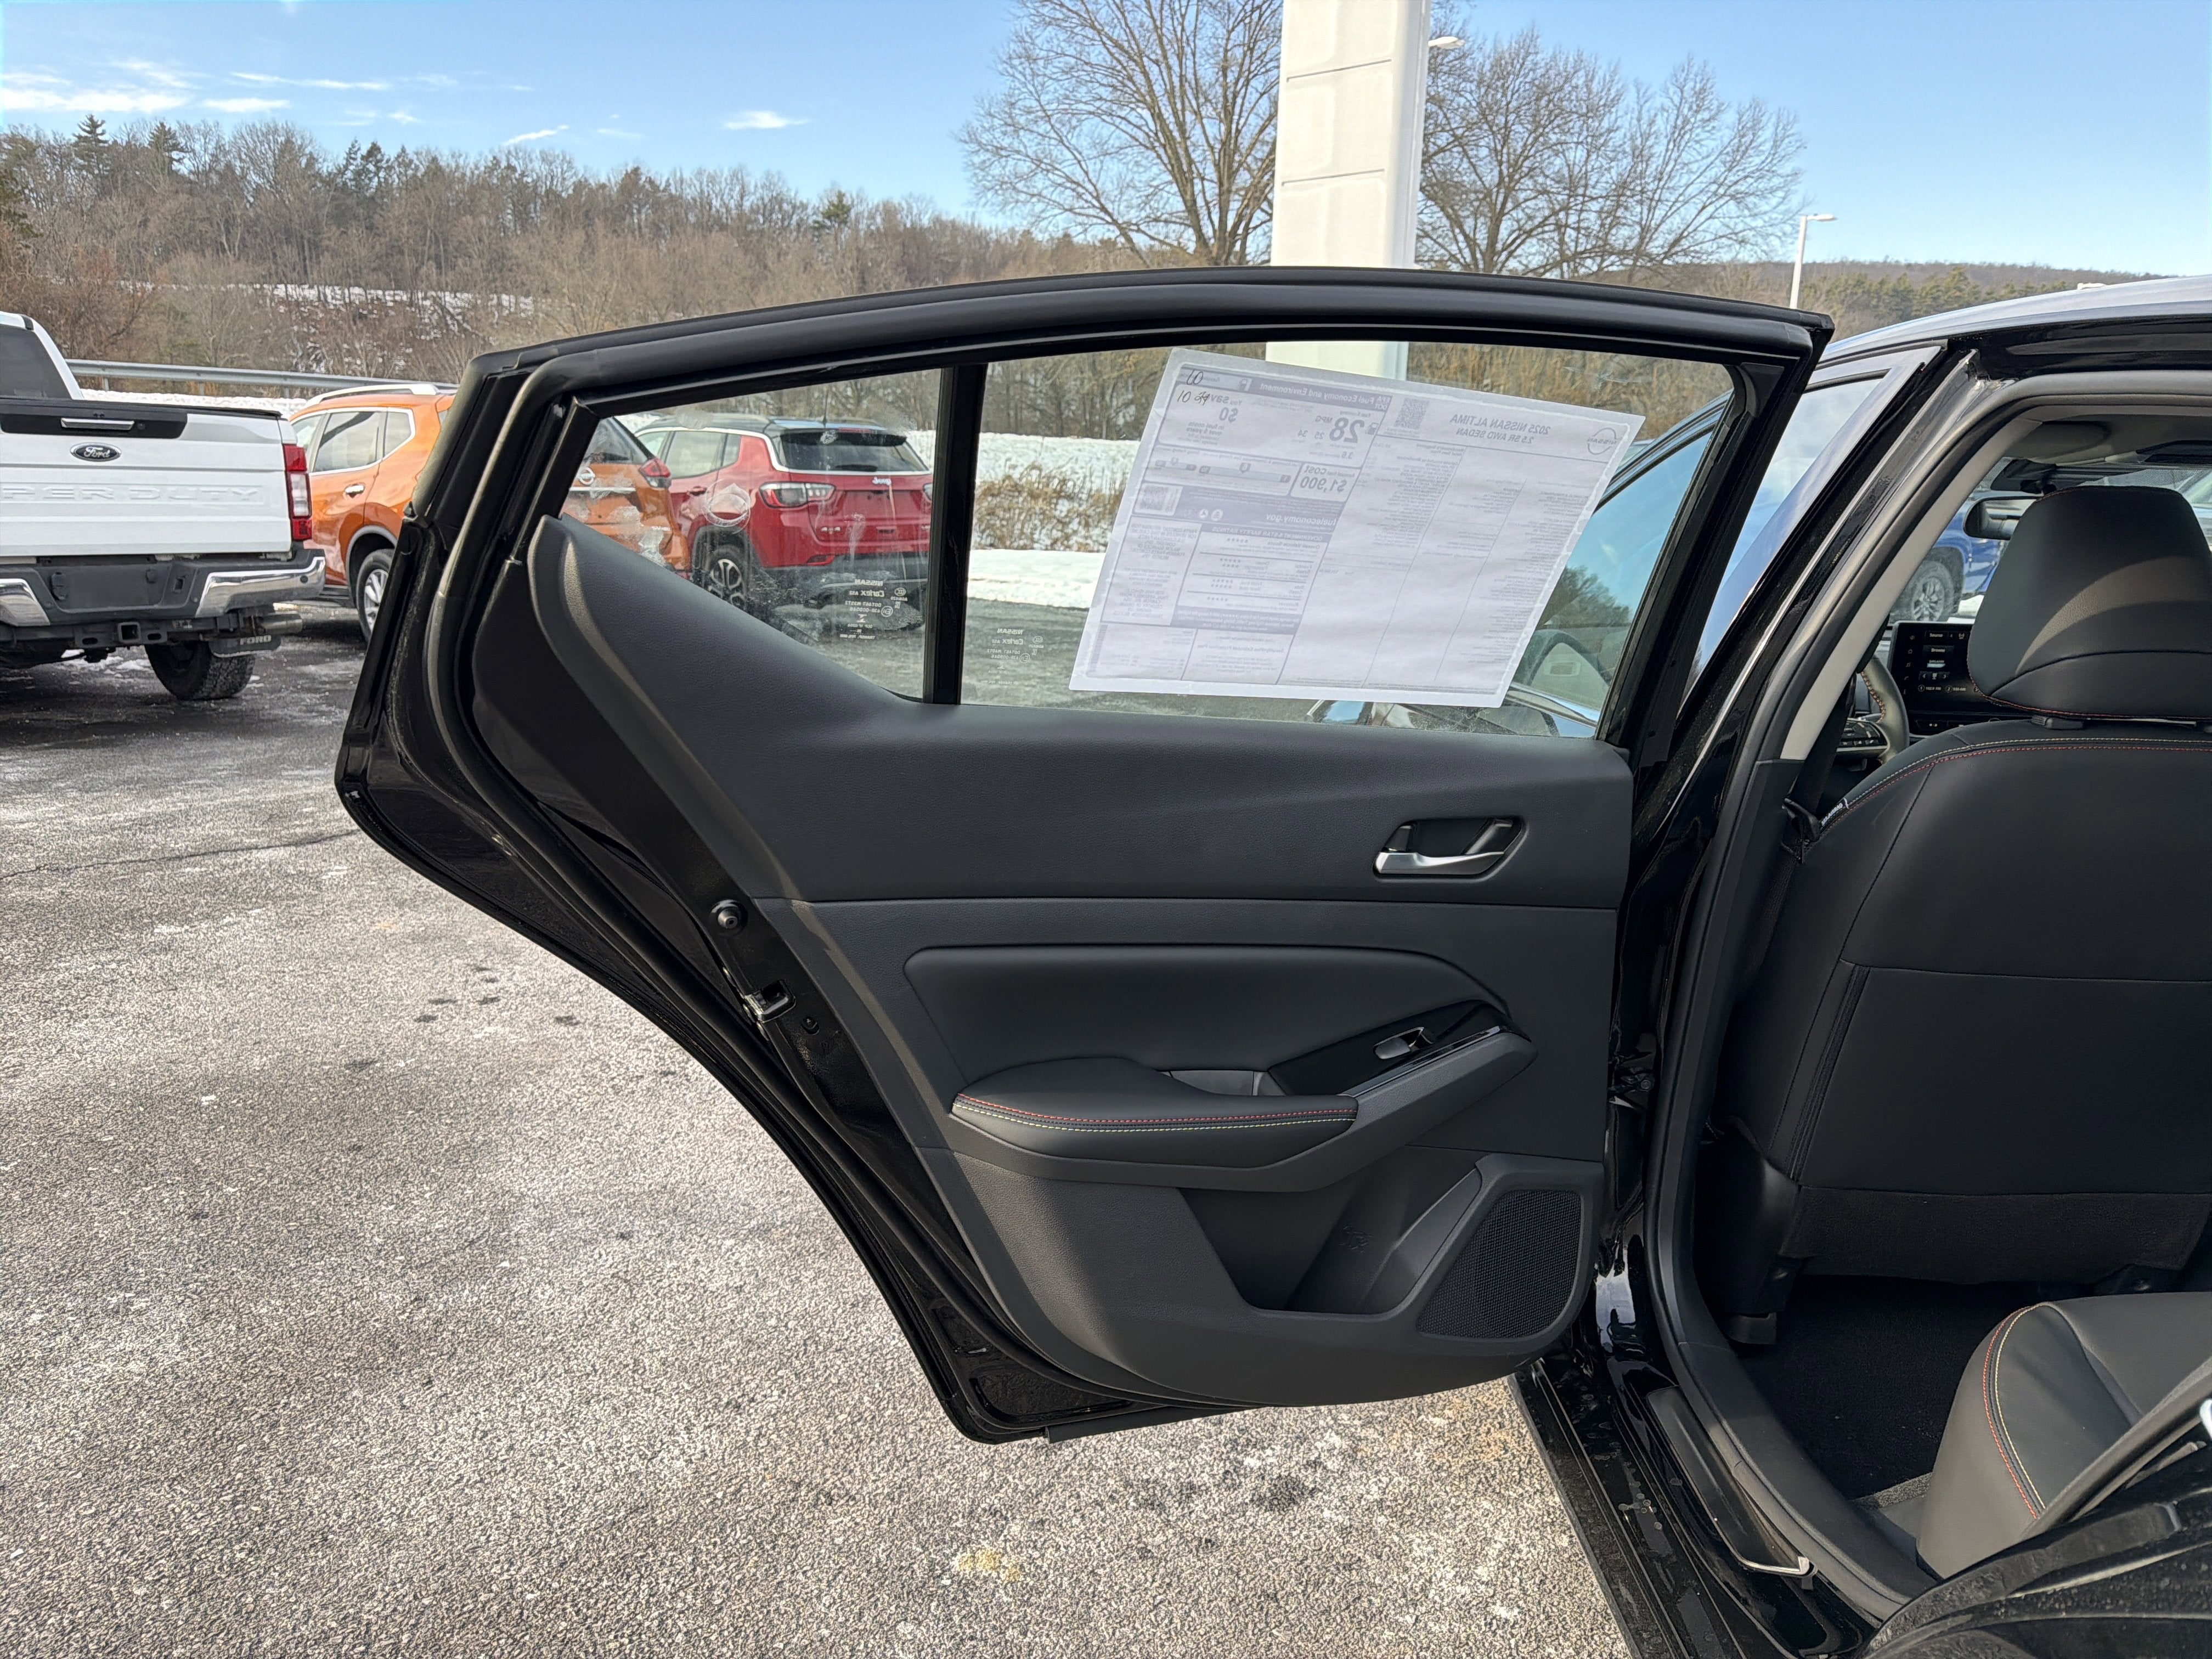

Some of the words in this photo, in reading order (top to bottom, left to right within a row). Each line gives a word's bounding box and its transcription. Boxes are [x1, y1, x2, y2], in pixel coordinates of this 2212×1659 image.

[84, 447, 110, 458] Ford
[872, 477, 891, 486] Jeep
[240, 635, 272, 645] FORD
